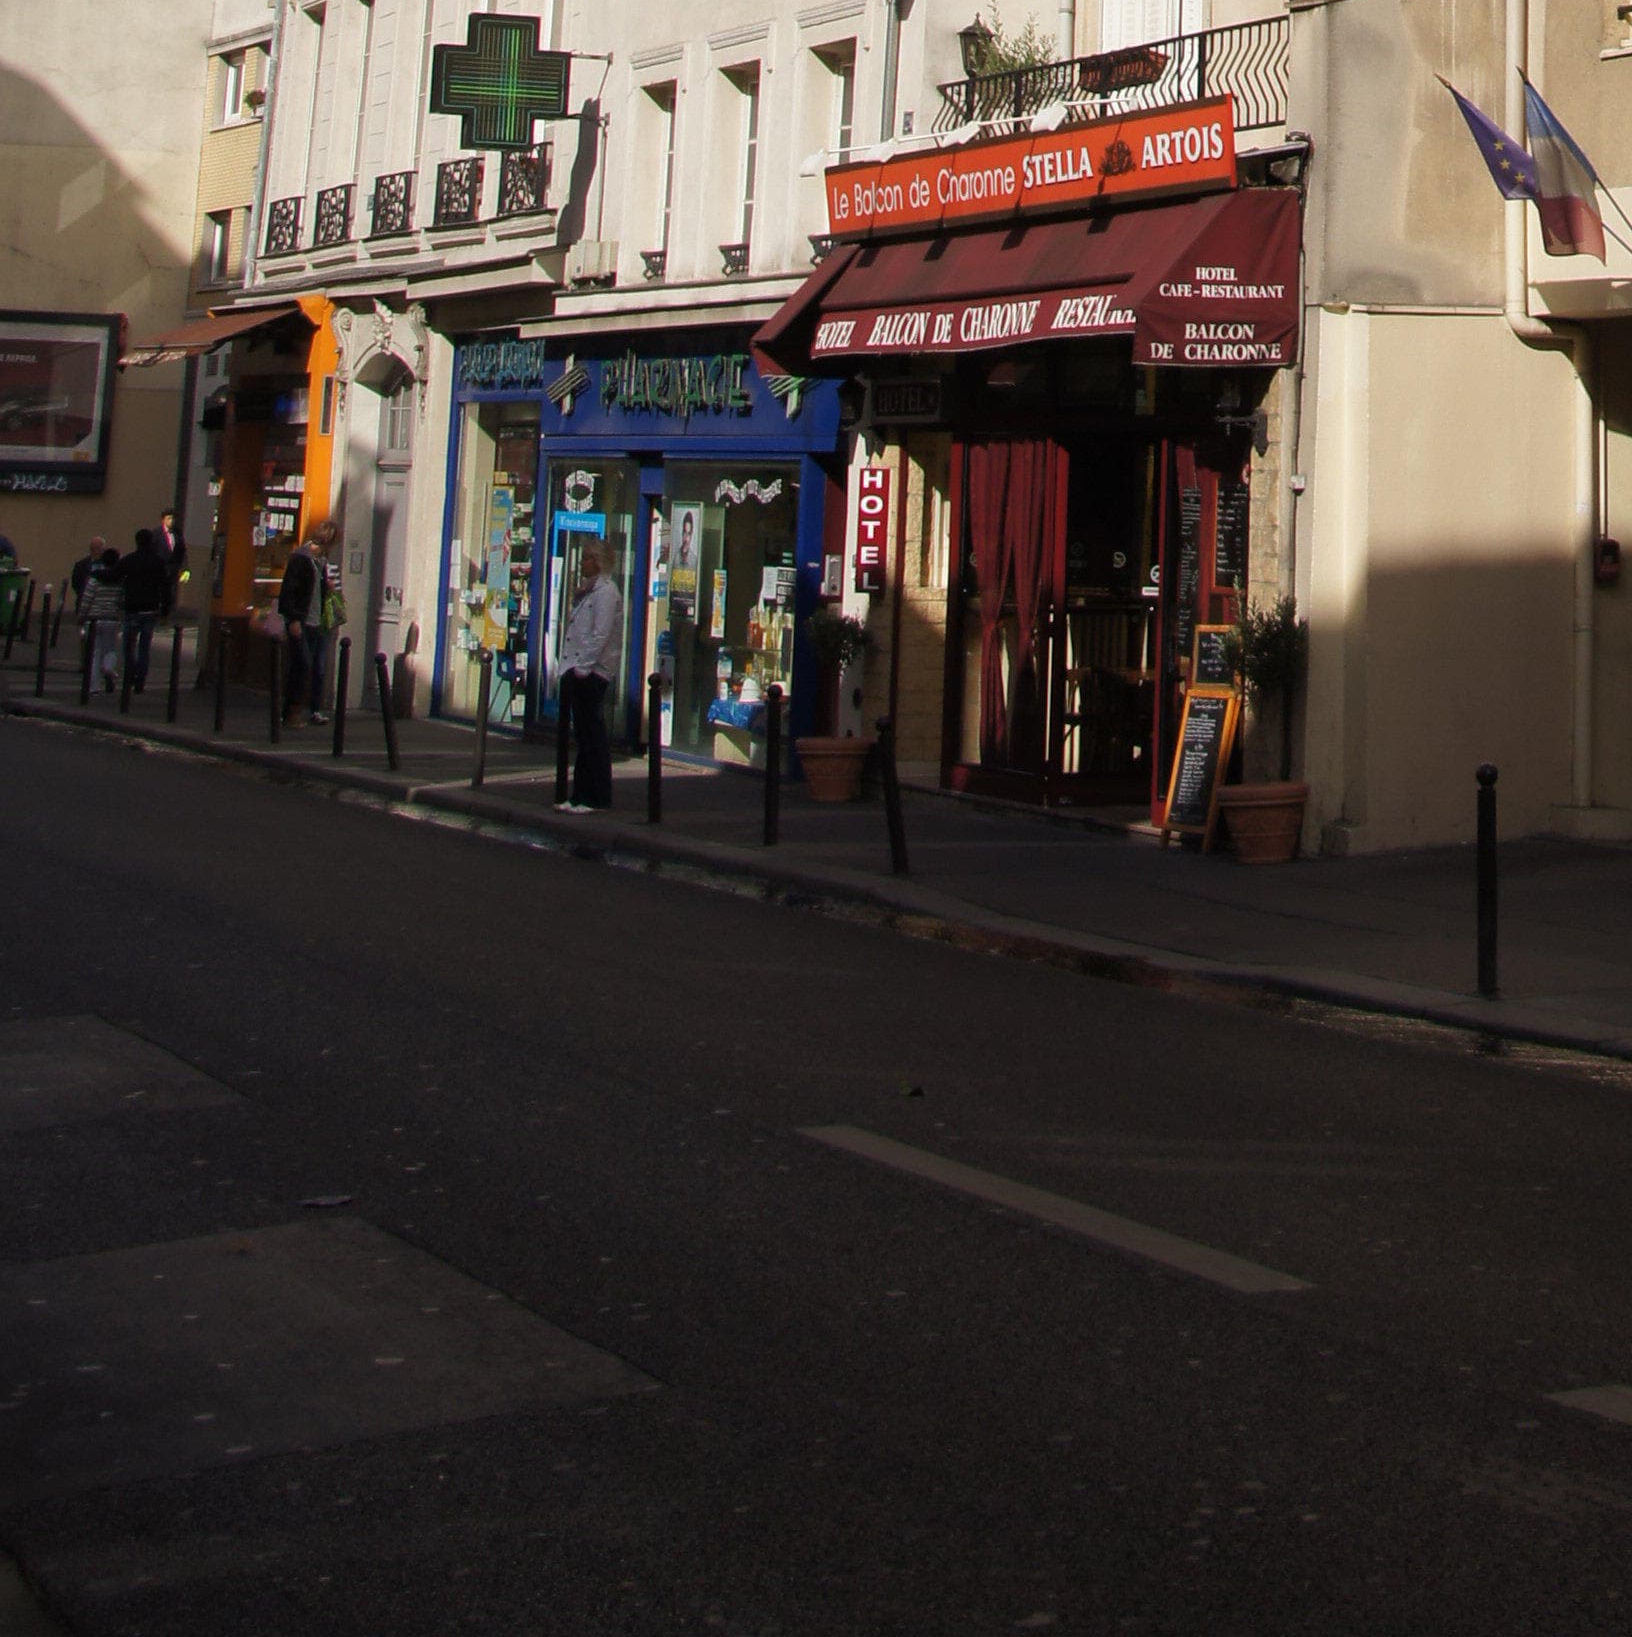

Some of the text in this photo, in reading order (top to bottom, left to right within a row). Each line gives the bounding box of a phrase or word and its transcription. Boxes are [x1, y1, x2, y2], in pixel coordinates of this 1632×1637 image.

[1022, 122, 1223, 189] STELLA ARTOIS
[833, 164, 1016, 220] Le Balcon de Charonne
[1195, 266, 1238, 281] HOTEL
[815, 320, 856, 350] HOTEL
[866, 311, 931, 346] BALCON
[932, 313, 954, 344] DE
[960, 300, 1041, 342] CHARONNE
[1150, 342, 1282, 361] DE CHARONNE
[1184, 323, 1255, 340] BALCON
[602, 353, 752, 411] PHARMACIE
[860, 470, 884, 590] HOTEL
